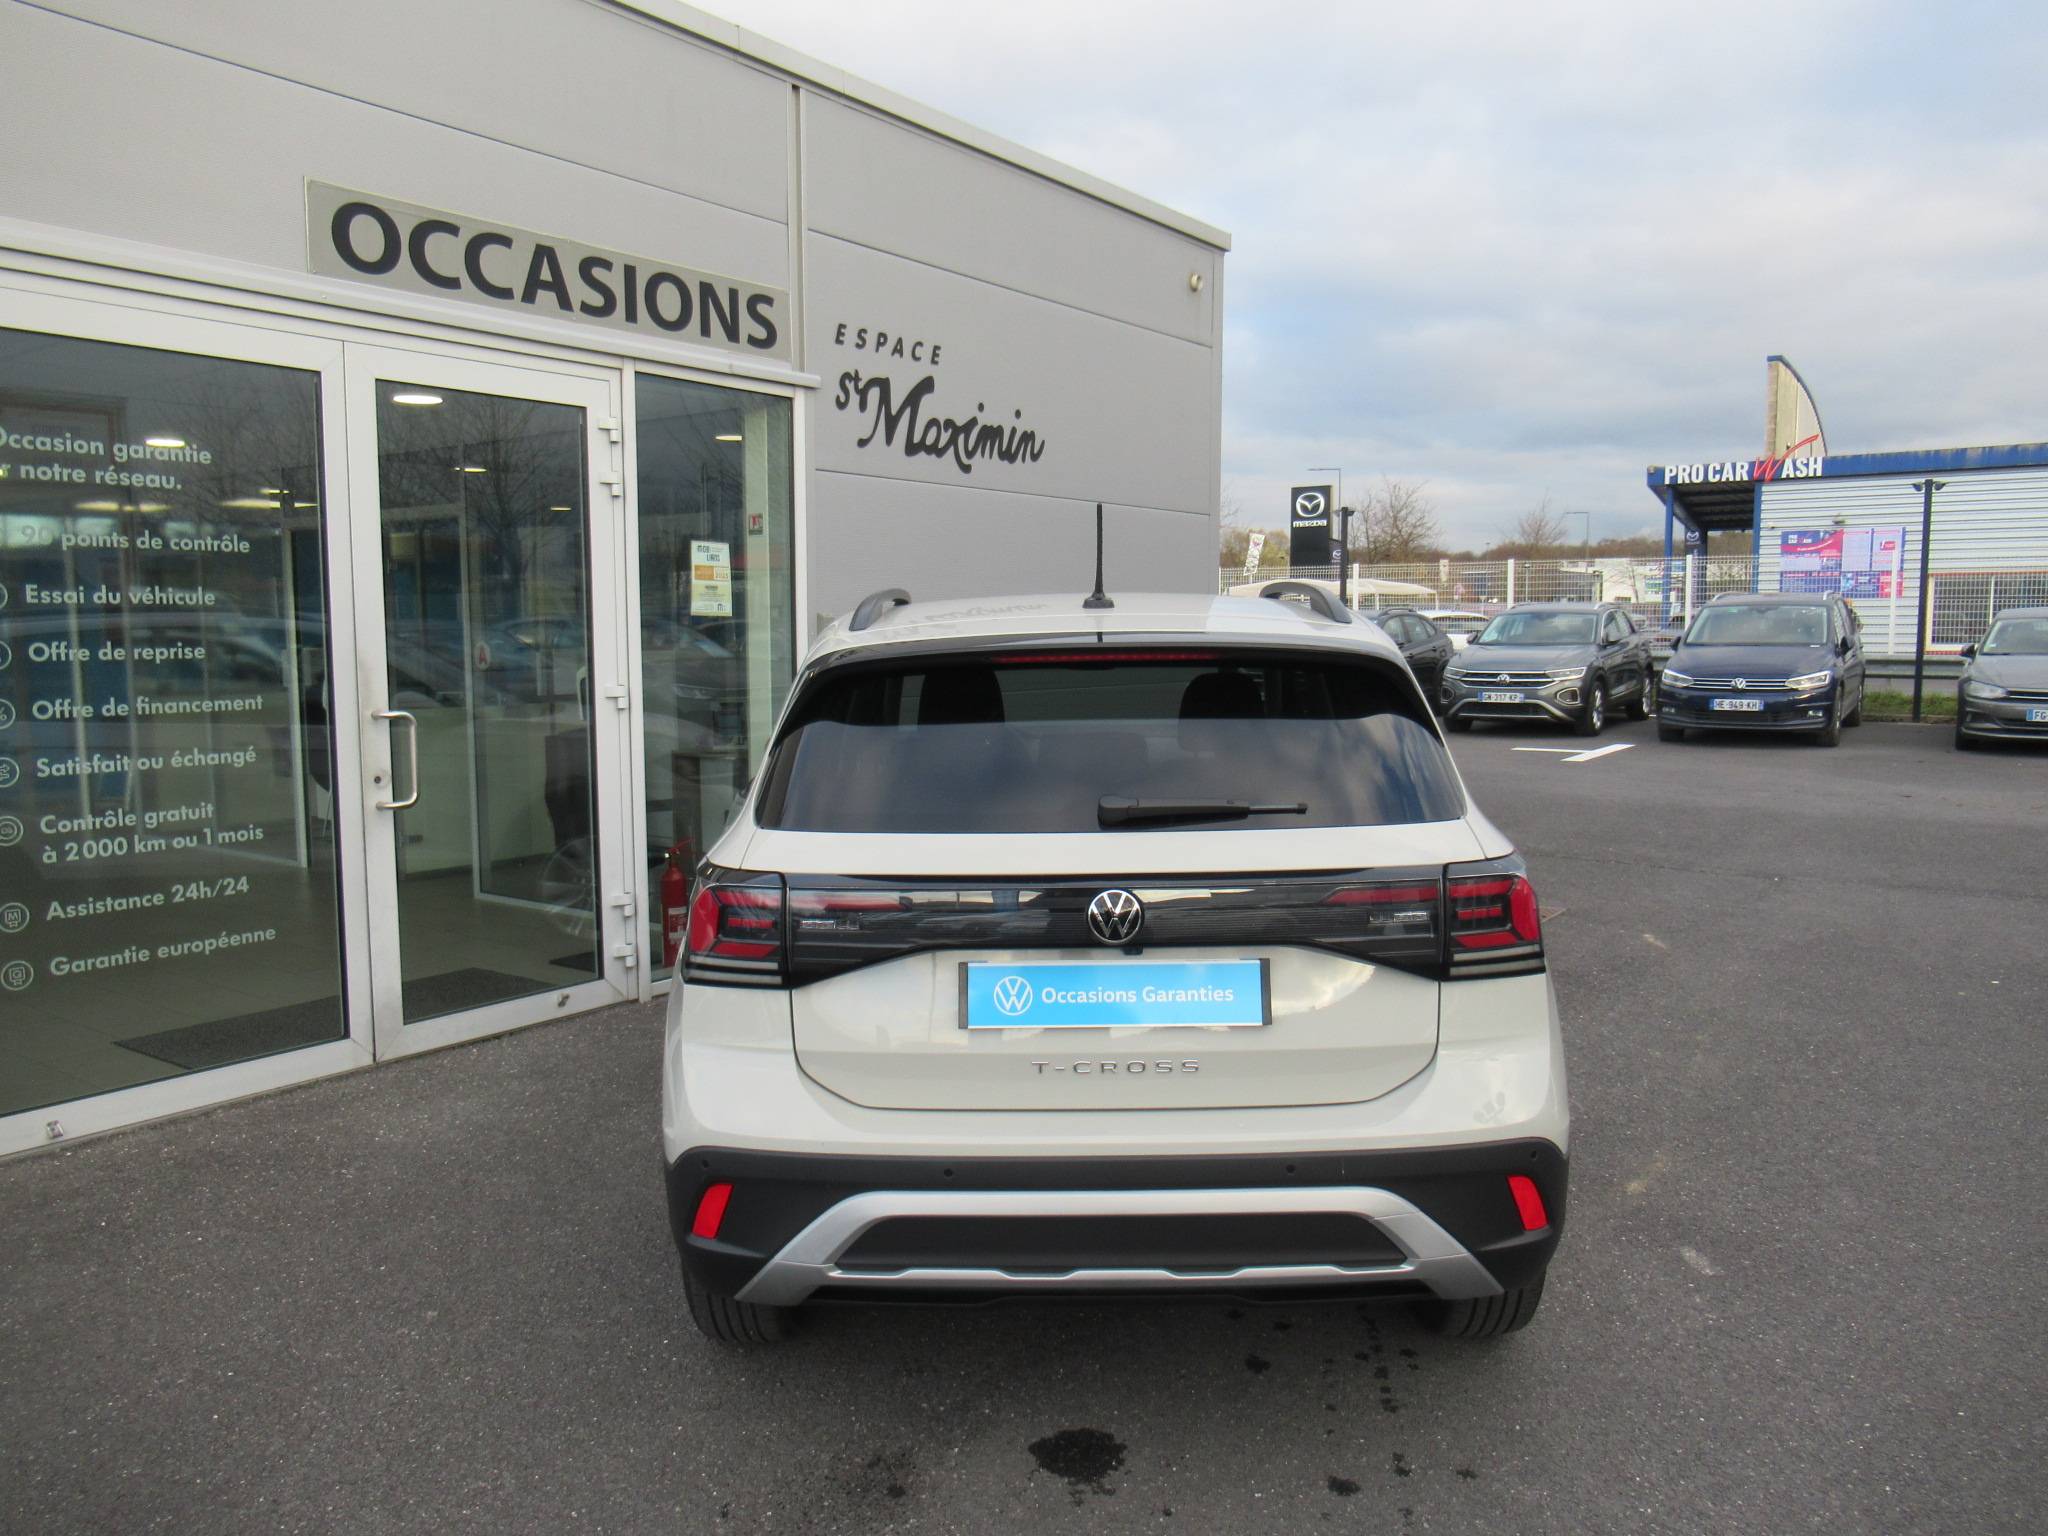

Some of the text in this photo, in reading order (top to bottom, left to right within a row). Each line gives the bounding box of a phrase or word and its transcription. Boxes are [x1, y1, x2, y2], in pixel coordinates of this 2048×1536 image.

[331, 202, 778, 350] OCCASIONS
[835, 323, 942, 365] ESPACE
[835, 369, 1046, 474] St Maximin
[113, 442, 213, 464] garantie
[1664, 445, 1824, 486] PRO CAR WASH
[20, 463, 87, 483] notre
[95, 466, 183, 491] réseau.
[1293, 518, 1329, 528] mazda
[61, 532, 130, 550] points
[136, 530, 164, 550] de
[169, 533, 251, 553] contrôle
[25, 584, 216, 607] Essai du véhicule
[28, 640, 207, 664] Offre de reprise
[32, 695, 264, 720] Offre de financement
[36, 746, 257, 778] Satisfait ou échangé
[40, 802, 215, 835] Contrôle gratuit
[42, 846, 58, 864] à
[134, 835, 167, 854] km
[172, 834, 198, 849] ou
[203, 828, 213, 845] 1
[217, 825, 265, 842] mois
[46, 876, 250, 921] Assistance 24h/24
[50, 927, 277, 976] Garantie européenne
[1041, 987, 1137, 1004] Occasions
[1142, 985, 1234, 1003] Garanties
[1031, 1059, 1200, 1075] T-CROSS
